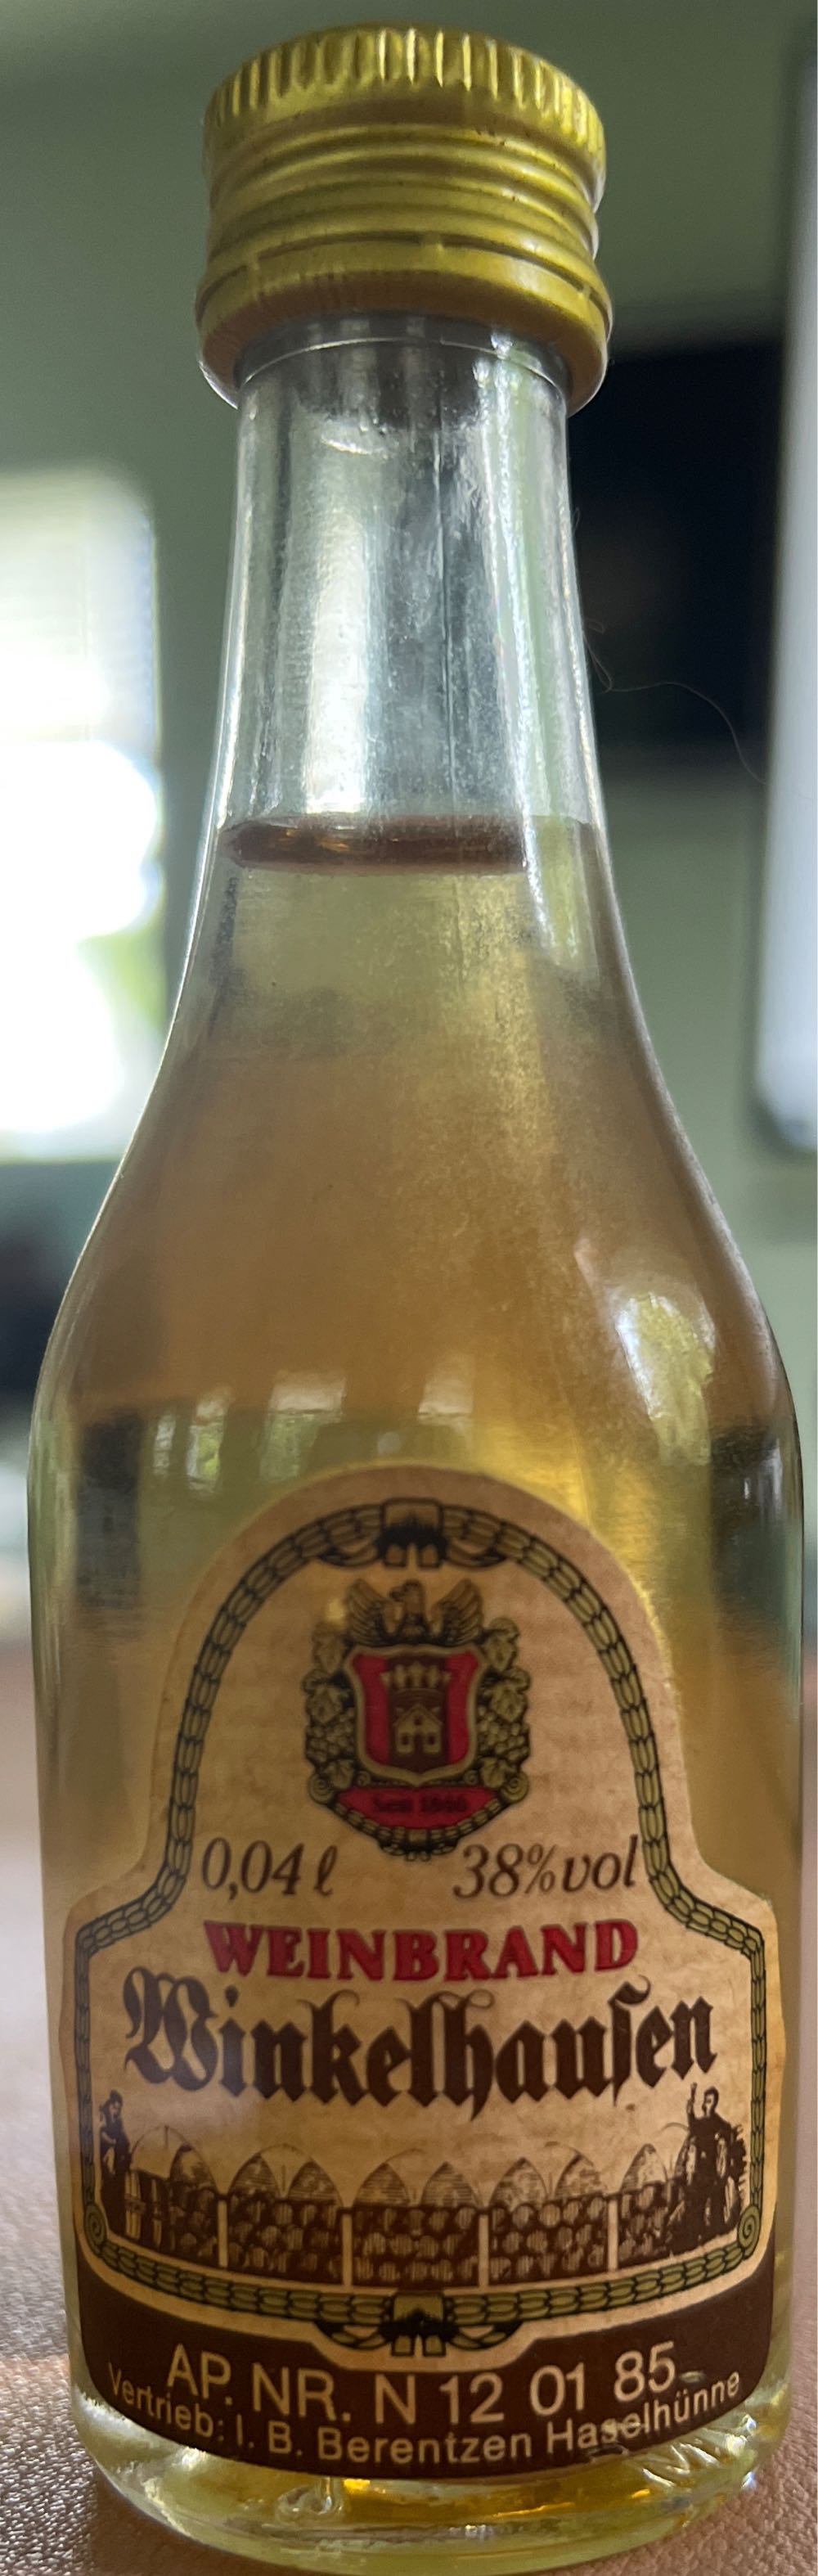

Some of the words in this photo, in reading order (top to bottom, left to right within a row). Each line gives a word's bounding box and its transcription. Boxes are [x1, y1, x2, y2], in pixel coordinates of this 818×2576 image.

[201, 1836, 303, 1901] 0,04
[204, 1919, 639, 1981] WEINBRAND
[108, 2361, 225, 2442] Vertrieb:
[267, 2421, 303, 2456] B.
[317, 2425, 532, 2464] Berentzen
[546, 2371, 741, 2453] Haselhünne
[167, 2343, 232, 2407] AP.
[252, 2362, 350, 2422] NR.
[375, 2372, 417, 2425] N
[438, 2371, 503, 2425] 12
[530, 2362, 586, 2416] 01
[614, 2340, 676, 2403] 85
